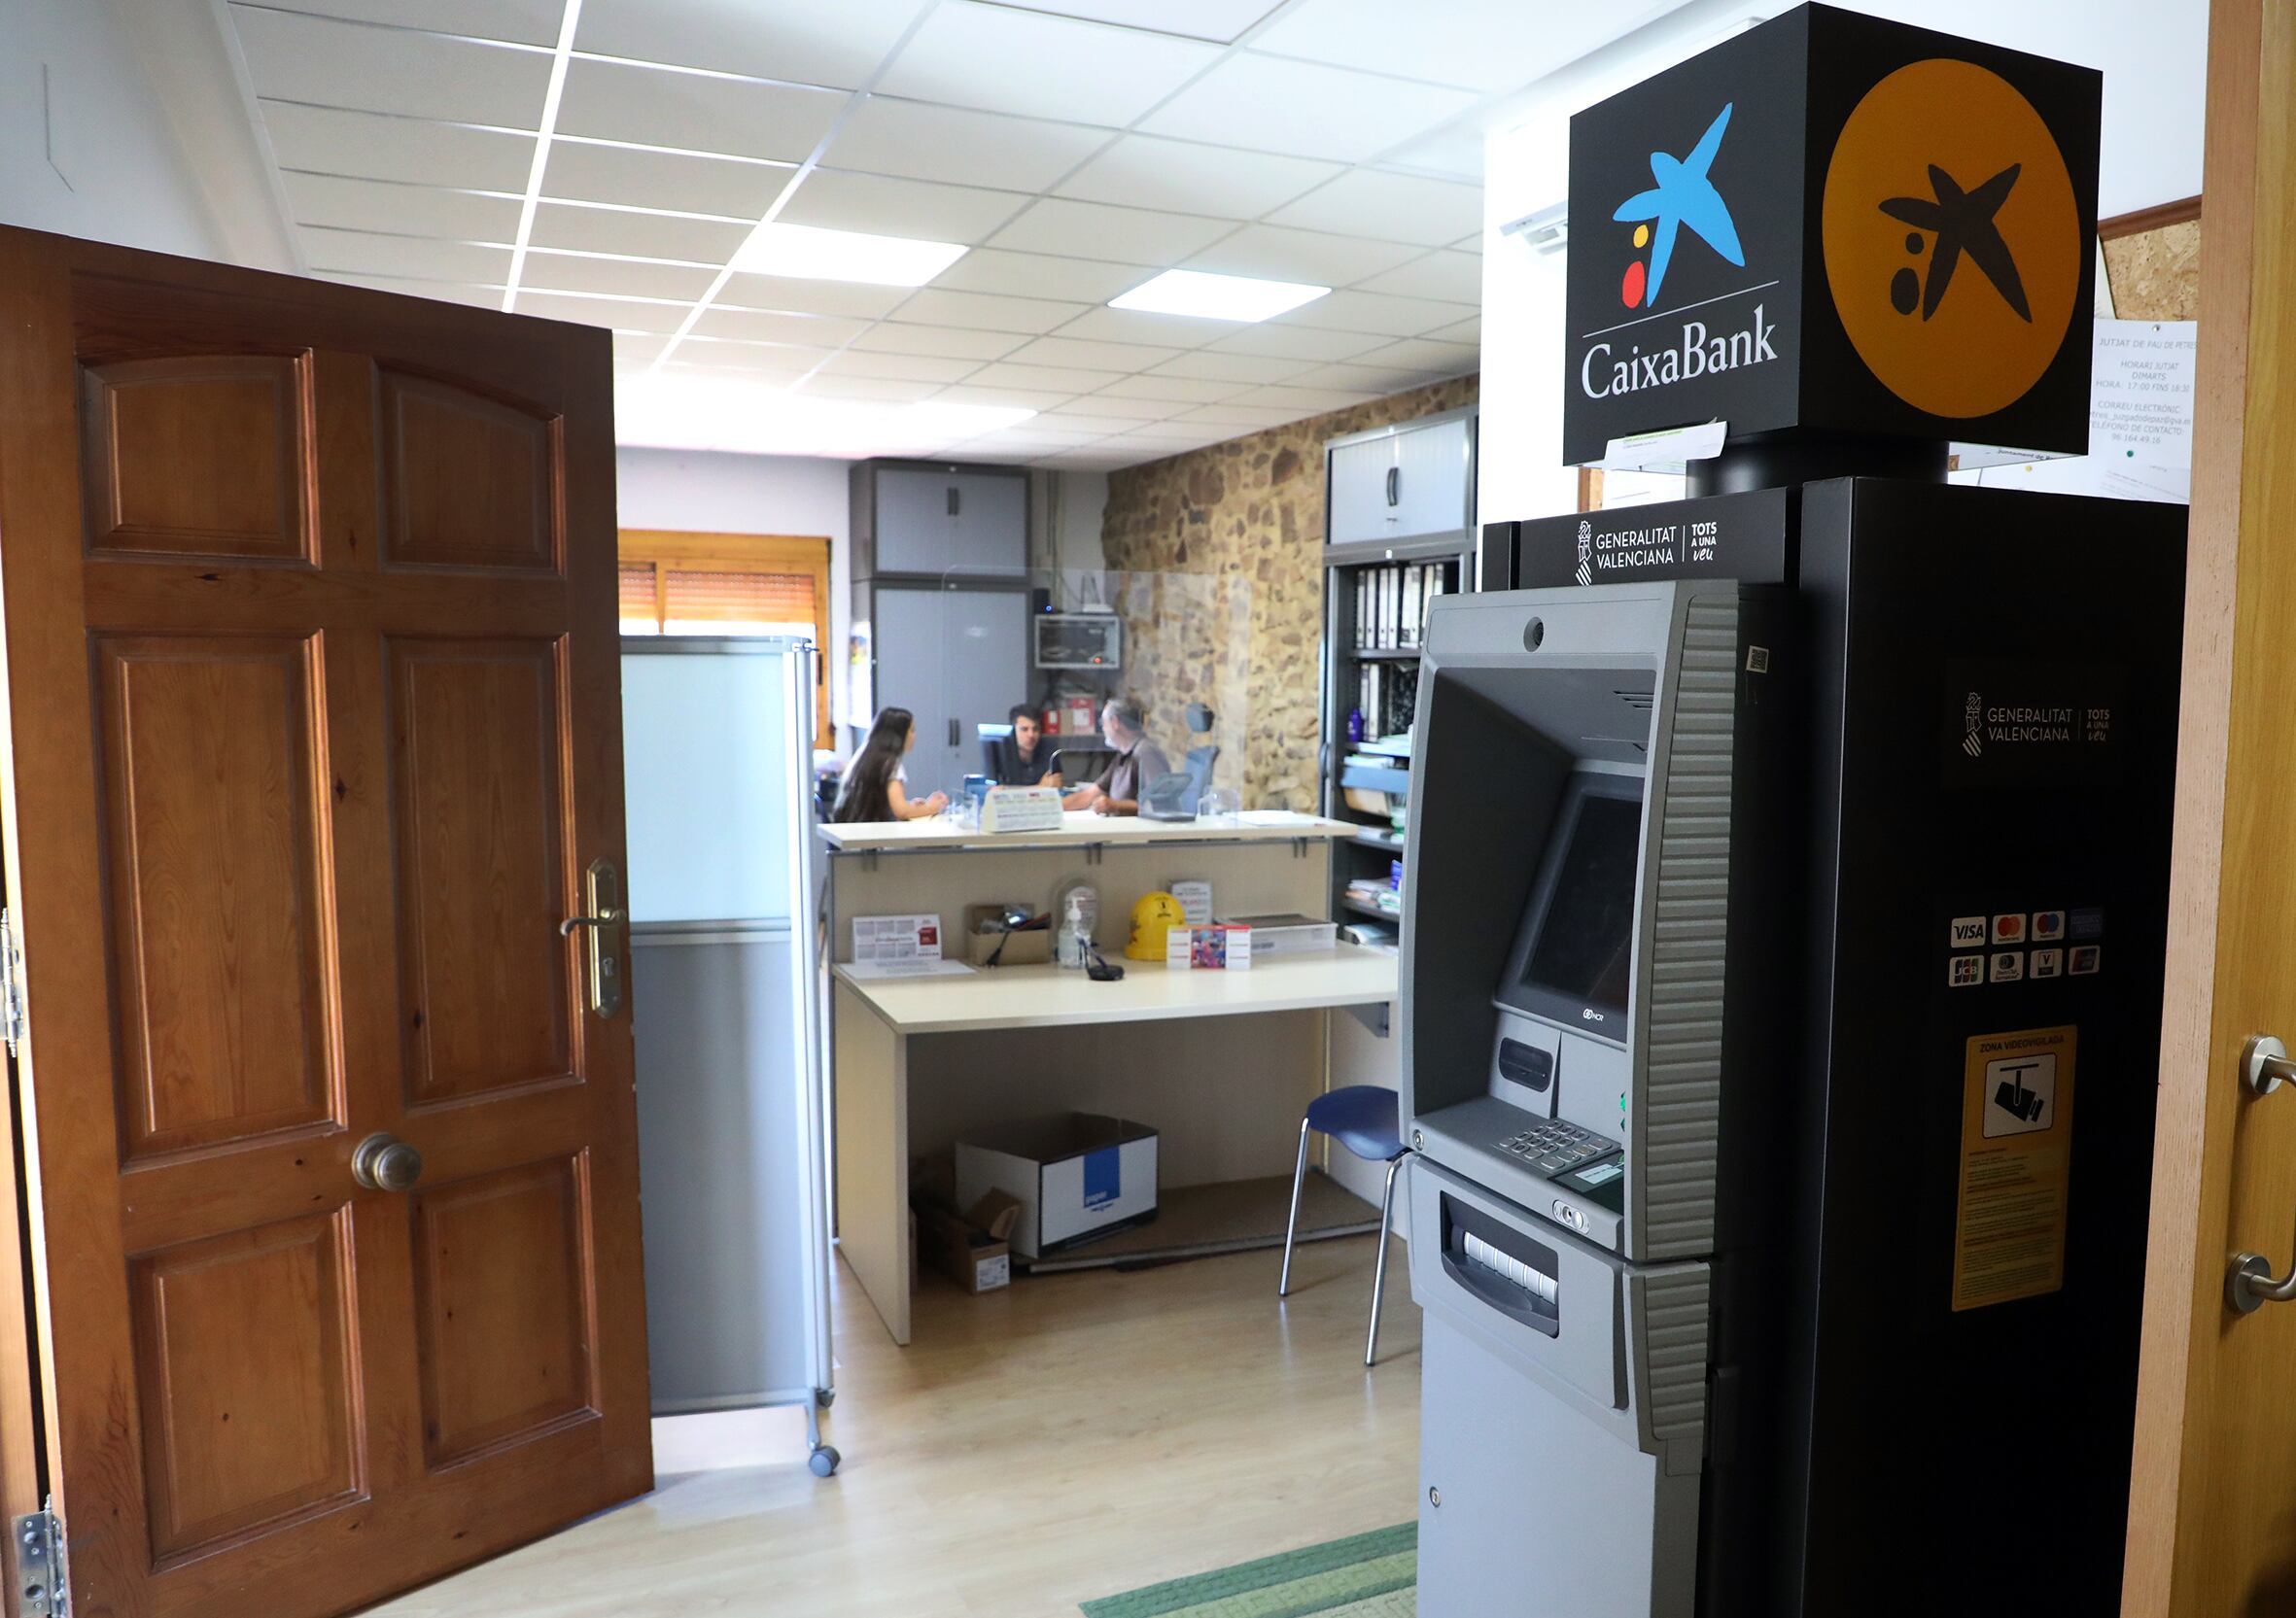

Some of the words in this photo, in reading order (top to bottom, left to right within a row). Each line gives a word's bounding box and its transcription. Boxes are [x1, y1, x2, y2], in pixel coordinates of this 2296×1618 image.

[2099, 338, 2130, 347] JUTJAT
[1582, 303, 1778, 399] CaixaBank
[2120, 361, 2153, 369] HORARI
[2154, 362, 2179, 371] JUTJAT
[2132, 371, 2168, 380] DIMARTS
[2152, 383, 2169, 392] FINS
[2098, 400, 2133, 410] CORREU
[2131, 424, 2141, 432] DE
[1691, 522, 1717, 536] TOTS
[1596, 526, 1677, 550] GENERALITAT
[1691, 537, 1697, 547] A
[1699, 535, 1717, 547] UNA
[1596, 547, 1674, 569] VALENCIANA
[1987, 707, 2073, 723] GENERALITAT
[2086, 708, 2110, 721] TOTS
[2094, 721, 2109, 730] UNA
[1988, 726, 2070, 741] VALENCIANA
[1954, 924, 1984, 940] VISA
[1955, 966, 1977, 976] JCB
[1979, 1042, 2002, 1053] ZONA
[2003, 1034, 2065, 1050] VIDEOVIGILADA
